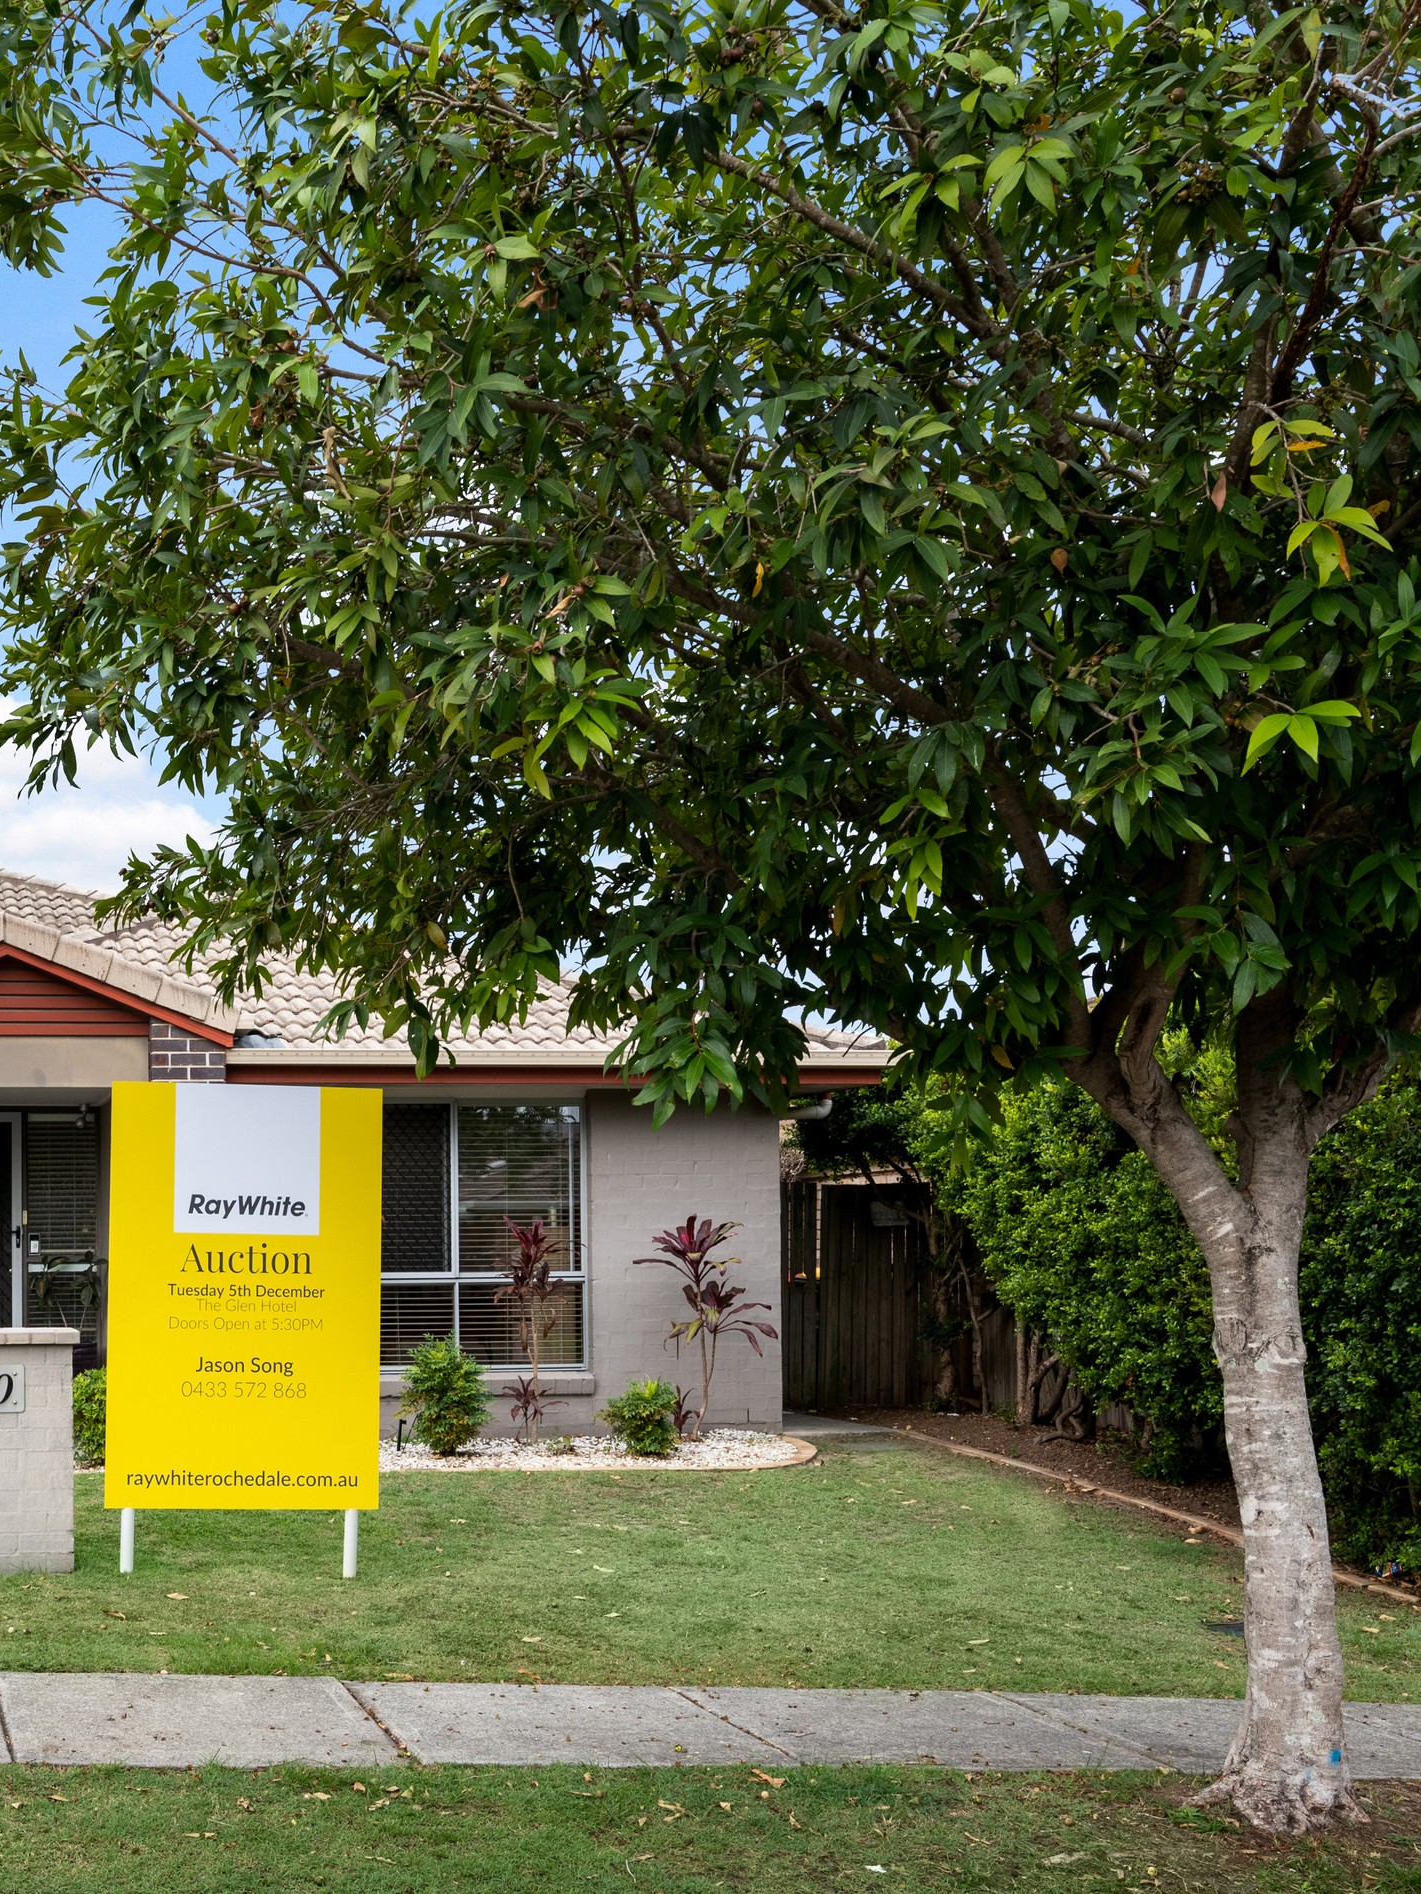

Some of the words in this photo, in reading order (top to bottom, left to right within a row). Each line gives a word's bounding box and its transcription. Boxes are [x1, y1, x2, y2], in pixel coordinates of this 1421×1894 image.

[180, 1243, 313, 1275] Auction
[168, 1283, 225, 1299] Tuesday
[229, 1284, 251, 1298] 5th
[255, 1285, 326, 1299] December
[196, 1298, 222, 1312] The
[225, 1299, 257, 1312] Glen
[261, 1299, 297, 1313] Hotel
[168, 1316, 210, 1330] Doors
[213, 1317, 251, 1332] Open
[254, 1319, 267, 1331] at
[271, 1318, 324, 1331] 5:30PM
[196, 1357, 245, 1373] Jason
[251, 1357, 294, 1377] Song
[181, 1381, 227, 1398] 0433
[233, 1382, 267, 1398] 572
[273, 1382, 307, 1399] 868
[127, 1470, 358, 1488] raywhiterochedale.com.au
